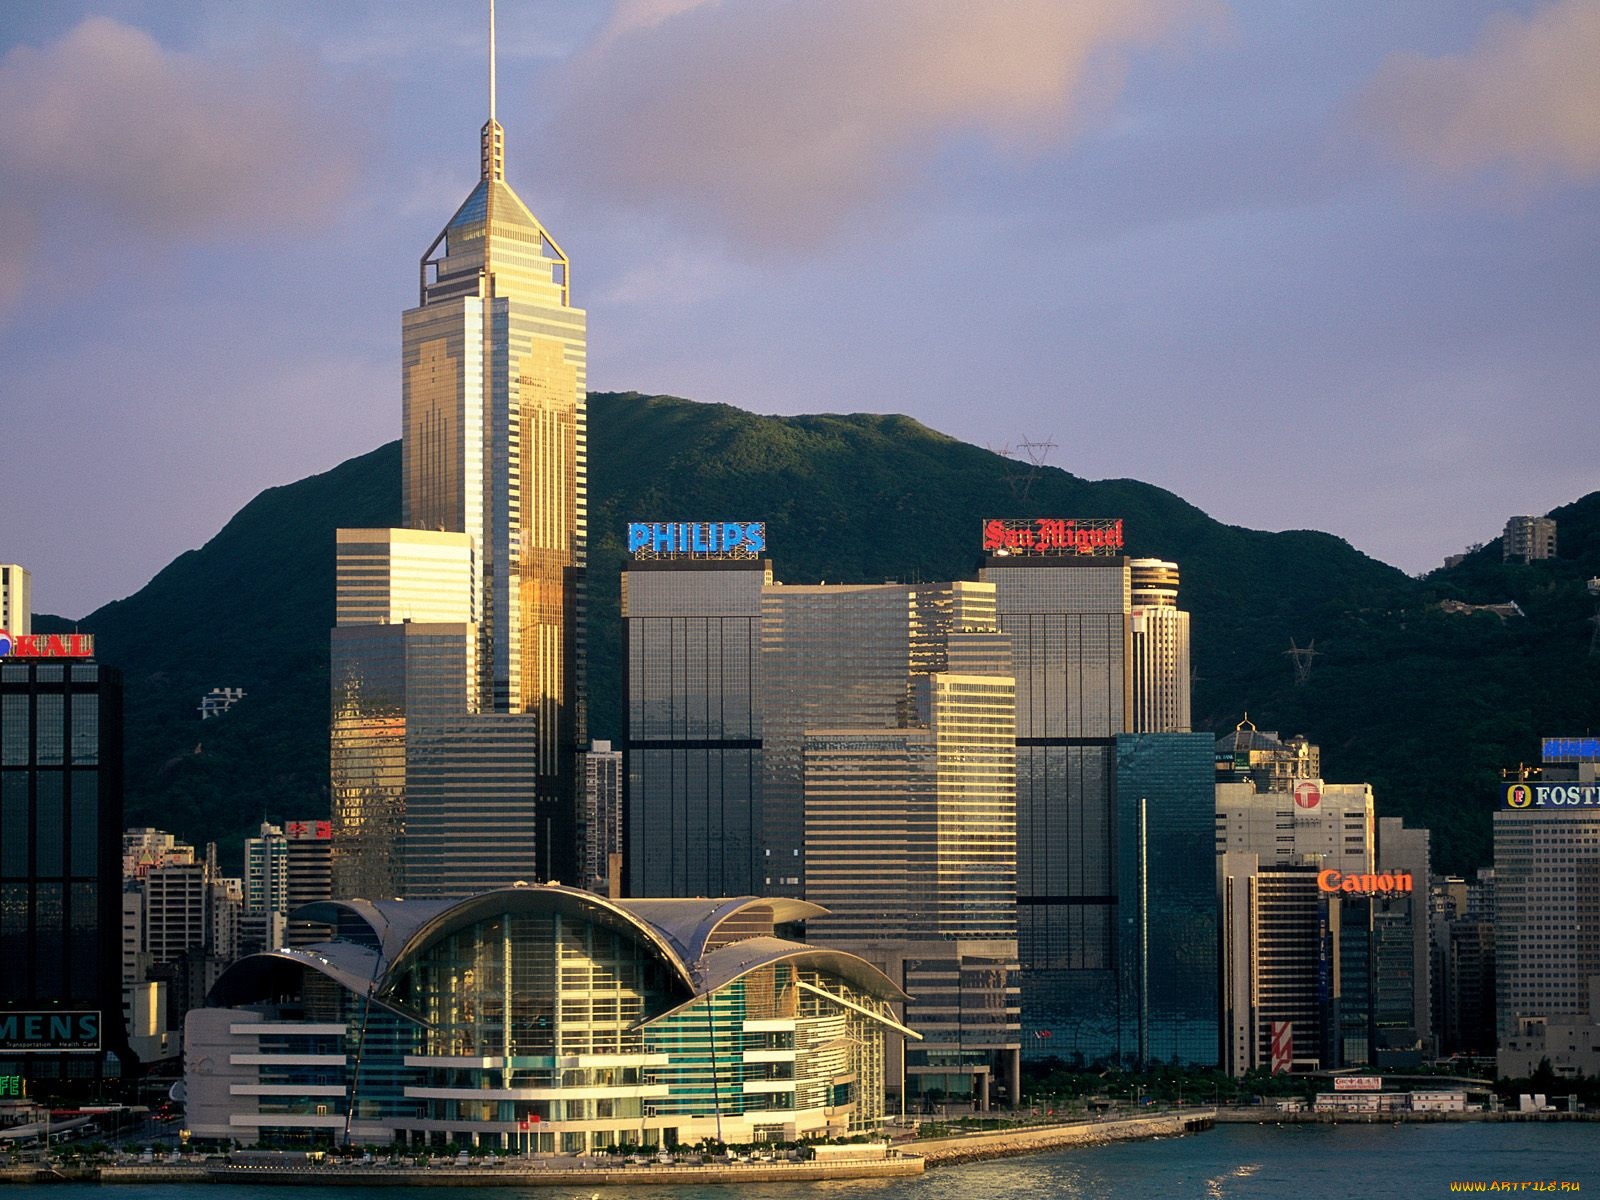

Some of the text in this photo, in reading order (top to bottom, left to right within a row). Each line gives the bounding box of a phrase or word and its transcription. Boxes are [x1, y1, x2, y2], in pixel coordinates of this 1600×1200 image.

[629, 523, 764, 553] PHILIPS
[984, 519, 1124, 552] San Miguel
[15, 635, 93, 657] KAL
[1535, 786, 1600, 805] FOST
[1317, 869, 1412, 892] Canon
